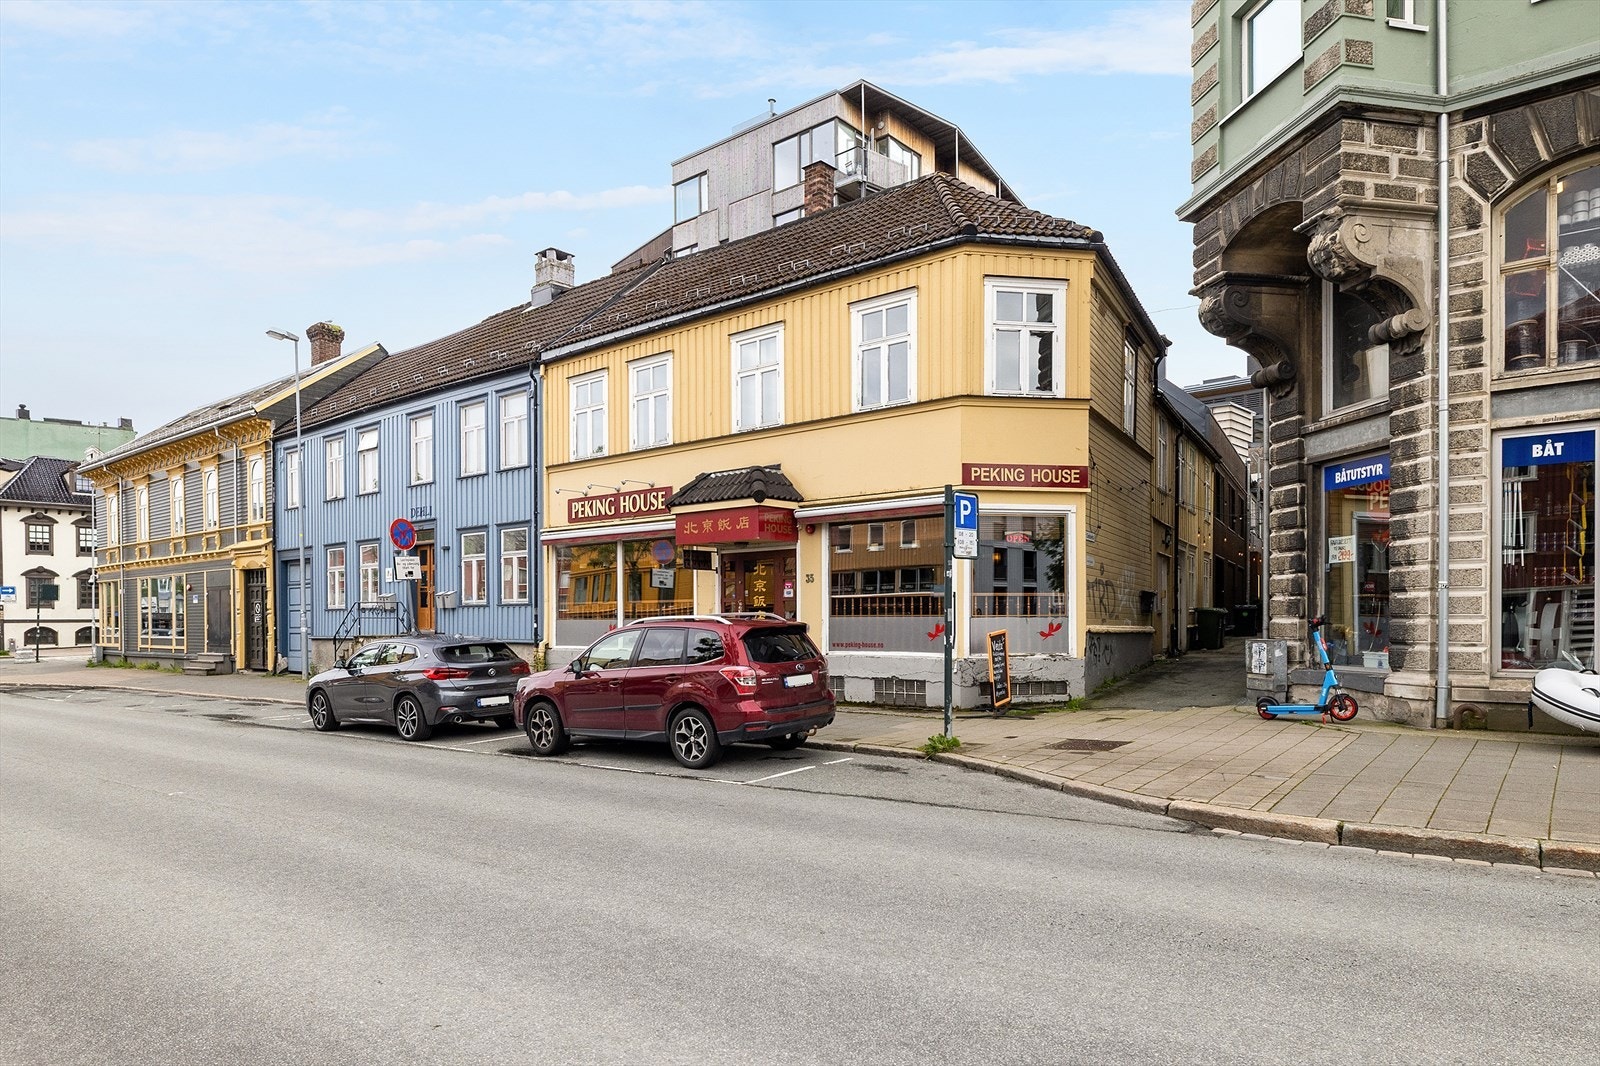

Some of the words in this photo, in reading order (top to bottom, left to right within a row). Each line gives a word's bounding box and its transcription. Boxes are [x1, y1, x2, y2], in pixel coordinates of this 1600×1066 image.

[1531, 438, 1564, 458] BÅT
[970, 467, 1025, 482] PEKING
[1031, 469, 1081, 483] HOUSE
[1335, 463, 1383, 483] BÅTUTSTYR
[410, 506, 432, 518] DEHLI
[571, 497, 616, 519] PEKING
[619, 491, 666, 515] HOUSE
[960, 499, 972, 525] P
[683, 515, 751, 535] 北京飯店
[763, 512, 793, 524] PEKING
[764, 524, 793, 534] HOUSE
[1006, 533, 1030, 543] OPEN
[805, 573, 815, 584] 35
[831, 641, 884, 649] www.peking-house.no
